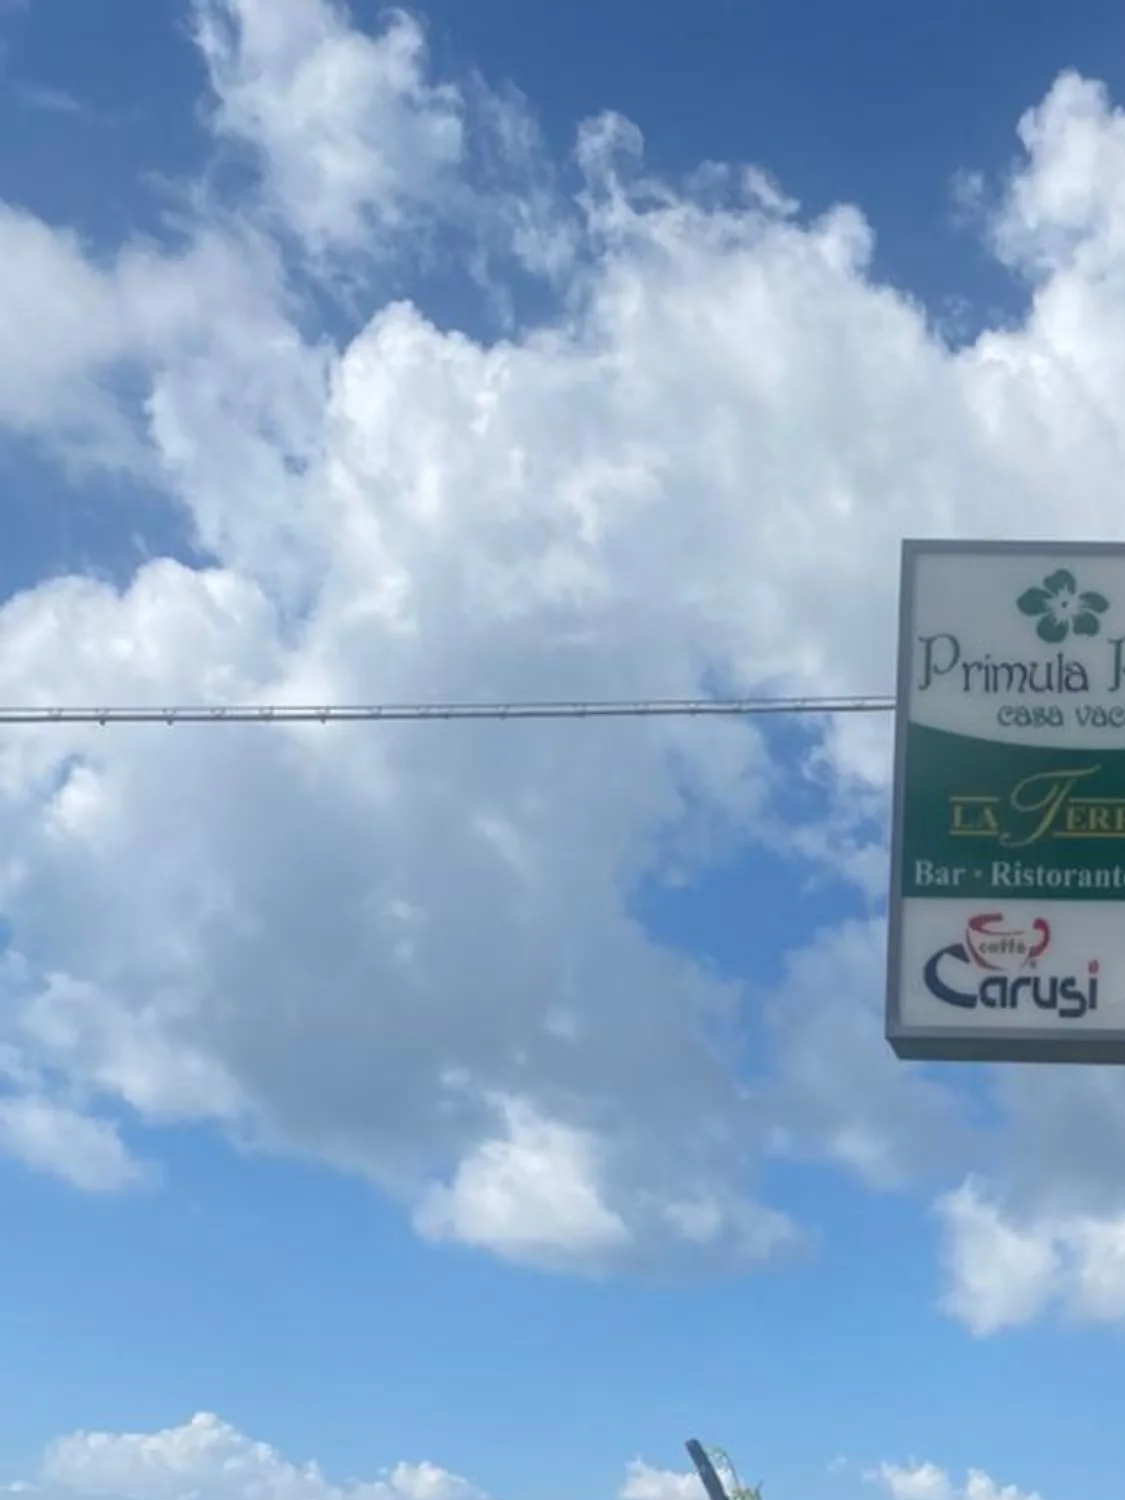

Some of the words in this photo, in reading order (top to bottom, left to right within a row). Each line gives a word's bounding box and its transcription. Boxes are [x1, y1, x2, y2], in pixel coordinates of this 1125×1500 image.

[918, 634, 1090, 694] Primula
[997, 704, 1064, 728] casa
[951, 803, 999, 831] LA
[914, 859, 967, 887] Bar
[923, 943, 1100, 1019] Carusi
